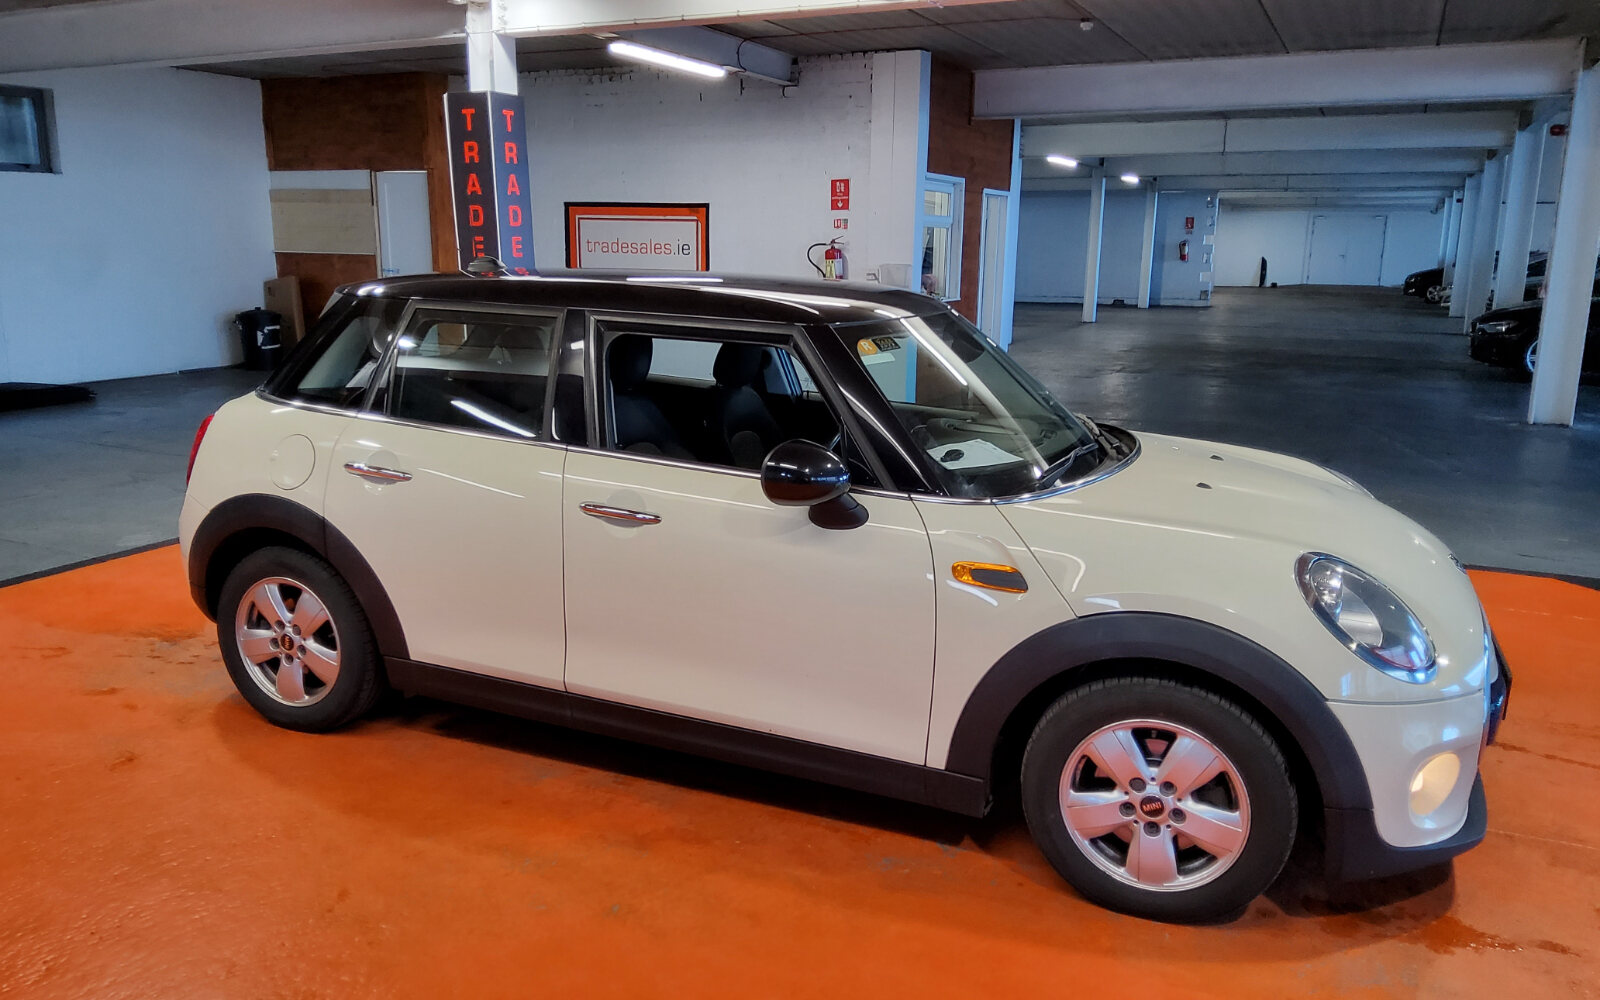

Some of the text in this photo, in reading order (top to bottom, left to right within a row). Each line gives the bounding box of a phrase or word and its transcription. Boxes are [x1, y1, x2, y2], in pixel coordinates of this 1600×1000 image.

[461, 108, 485, 257] TRADE
[502, 109, 524, 258] TRADE
[586, 238, 691, 256] tradesales.ie
[1142, 801, 1162, 812] MINI
